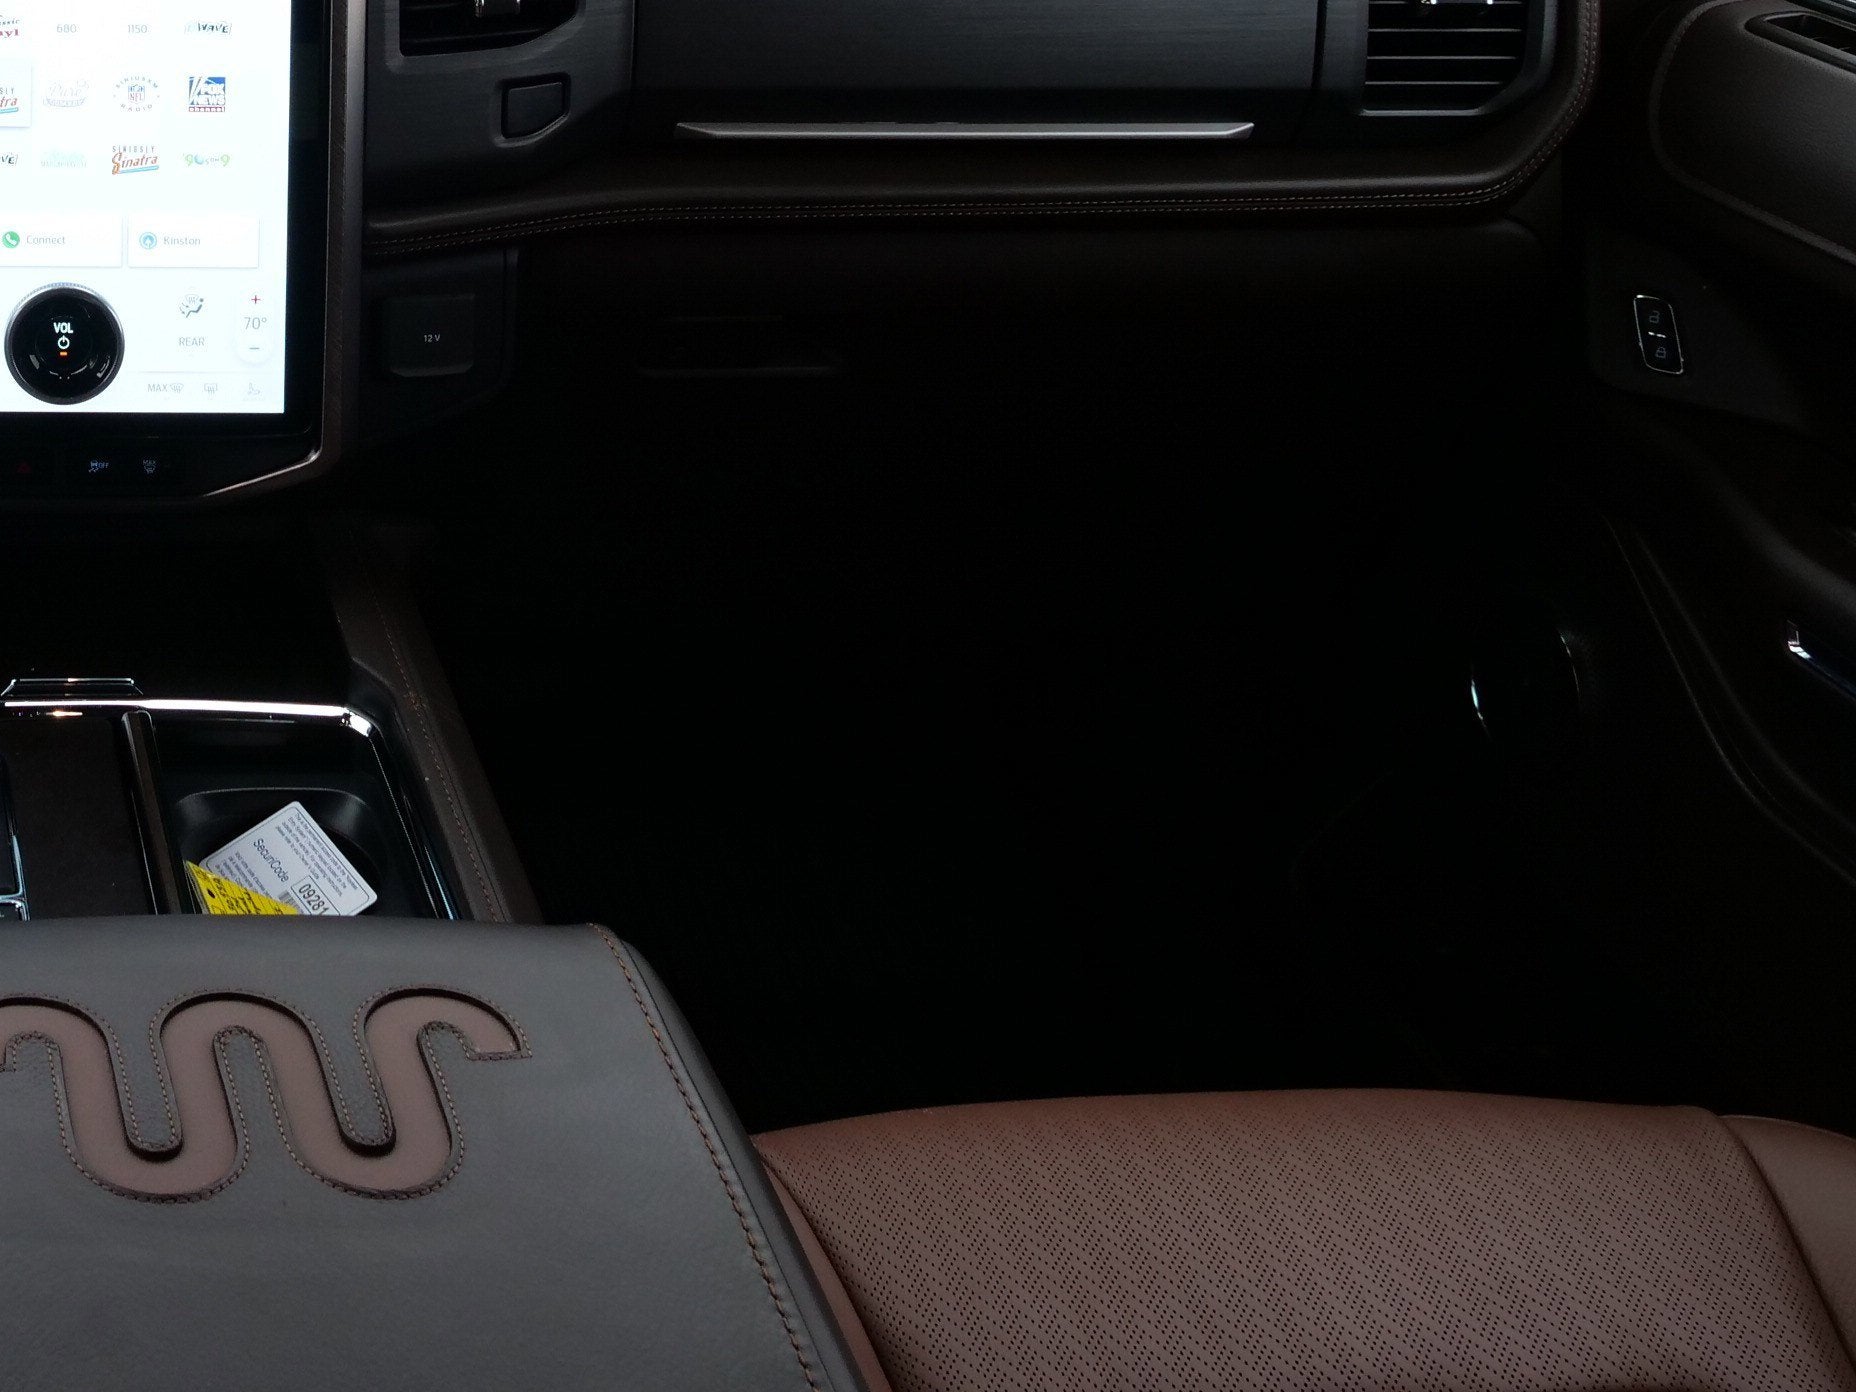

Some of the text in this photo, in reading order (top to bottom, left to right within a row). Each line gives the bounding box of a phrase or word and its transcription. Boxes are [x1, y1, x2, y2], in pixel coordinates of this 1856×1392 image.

[56, 24, 77, 34] 680
[127, 24, 148, 34] 1150
[193, 94, 226, 105] NEWS
[111, 151, 159, 174] Sinatra
[26, 234, 66, 245] Connect
[53, 321, 74, 334] VOL
[178, 336, 205, 346] REAR
[147, 383, 168, 392] MAX
[252, 837, 290, 883] SecuriCode
